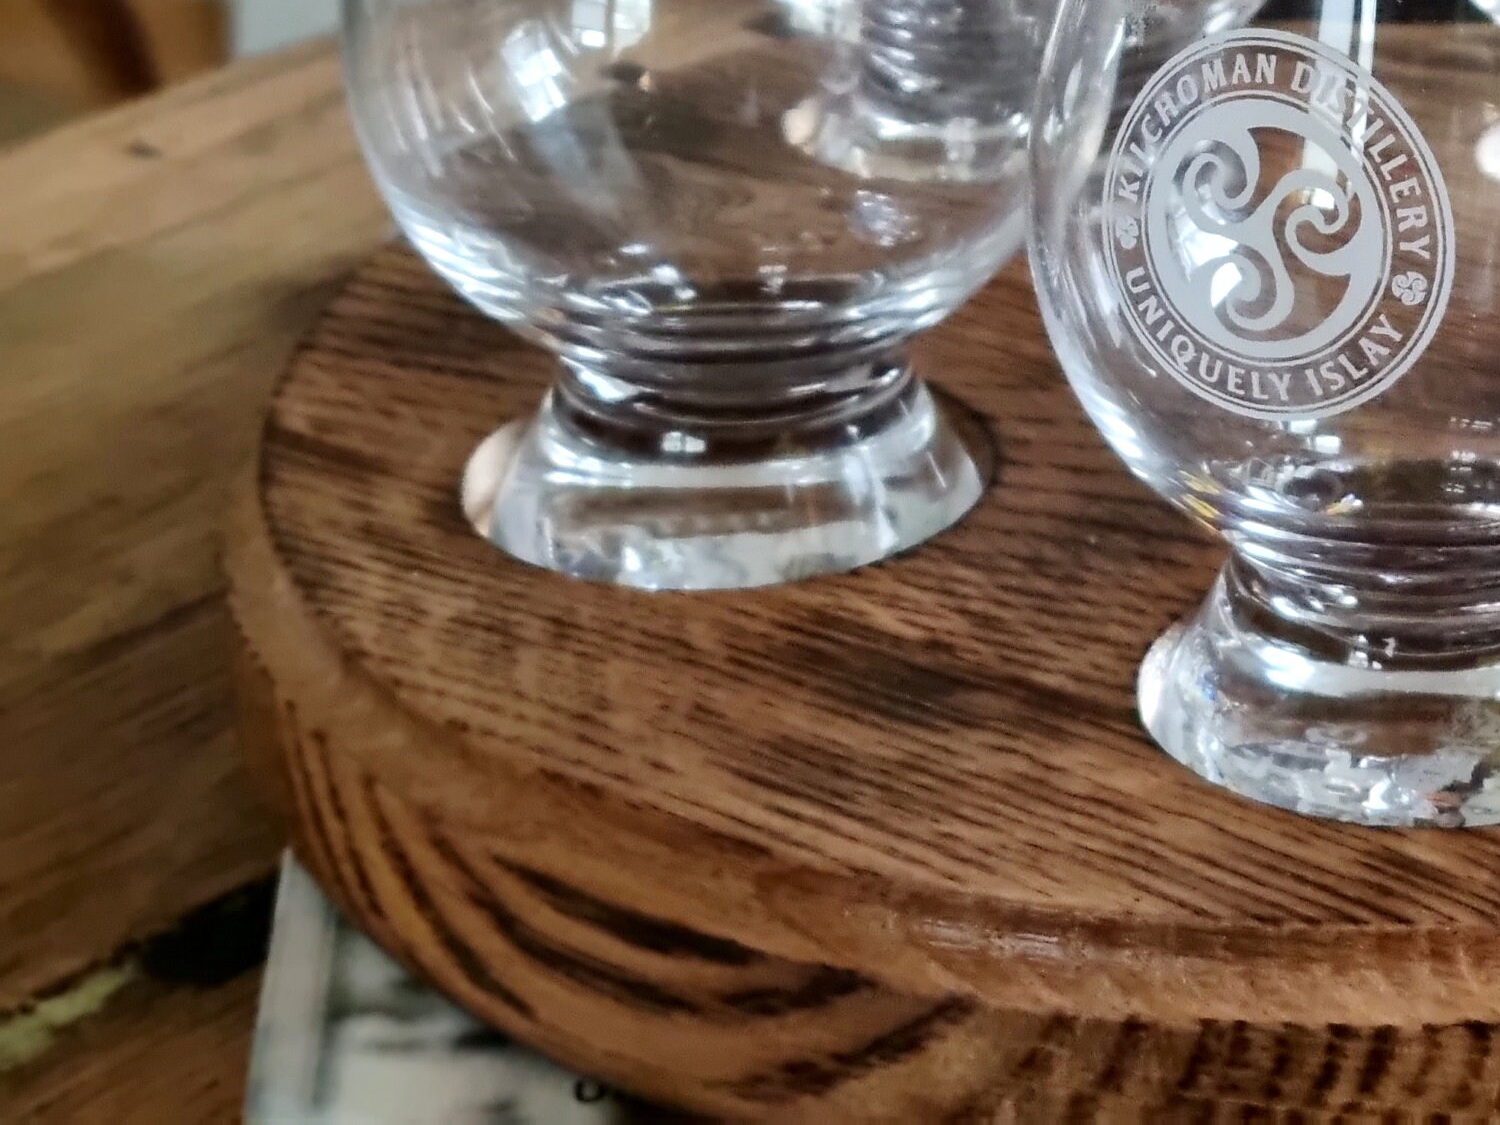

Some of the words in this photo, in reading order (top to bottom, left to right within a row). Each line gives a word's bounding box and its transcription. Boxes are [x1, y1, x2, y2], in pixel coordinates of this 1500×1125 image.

[1118, 53, 1277, 203] KILCHOMAN
[1291, 60, 1431, 259] DISTILLERY
[1126, 267, 1294, 402] UNIQUELY
[1303, 314, 1404, 396] ISLAY
